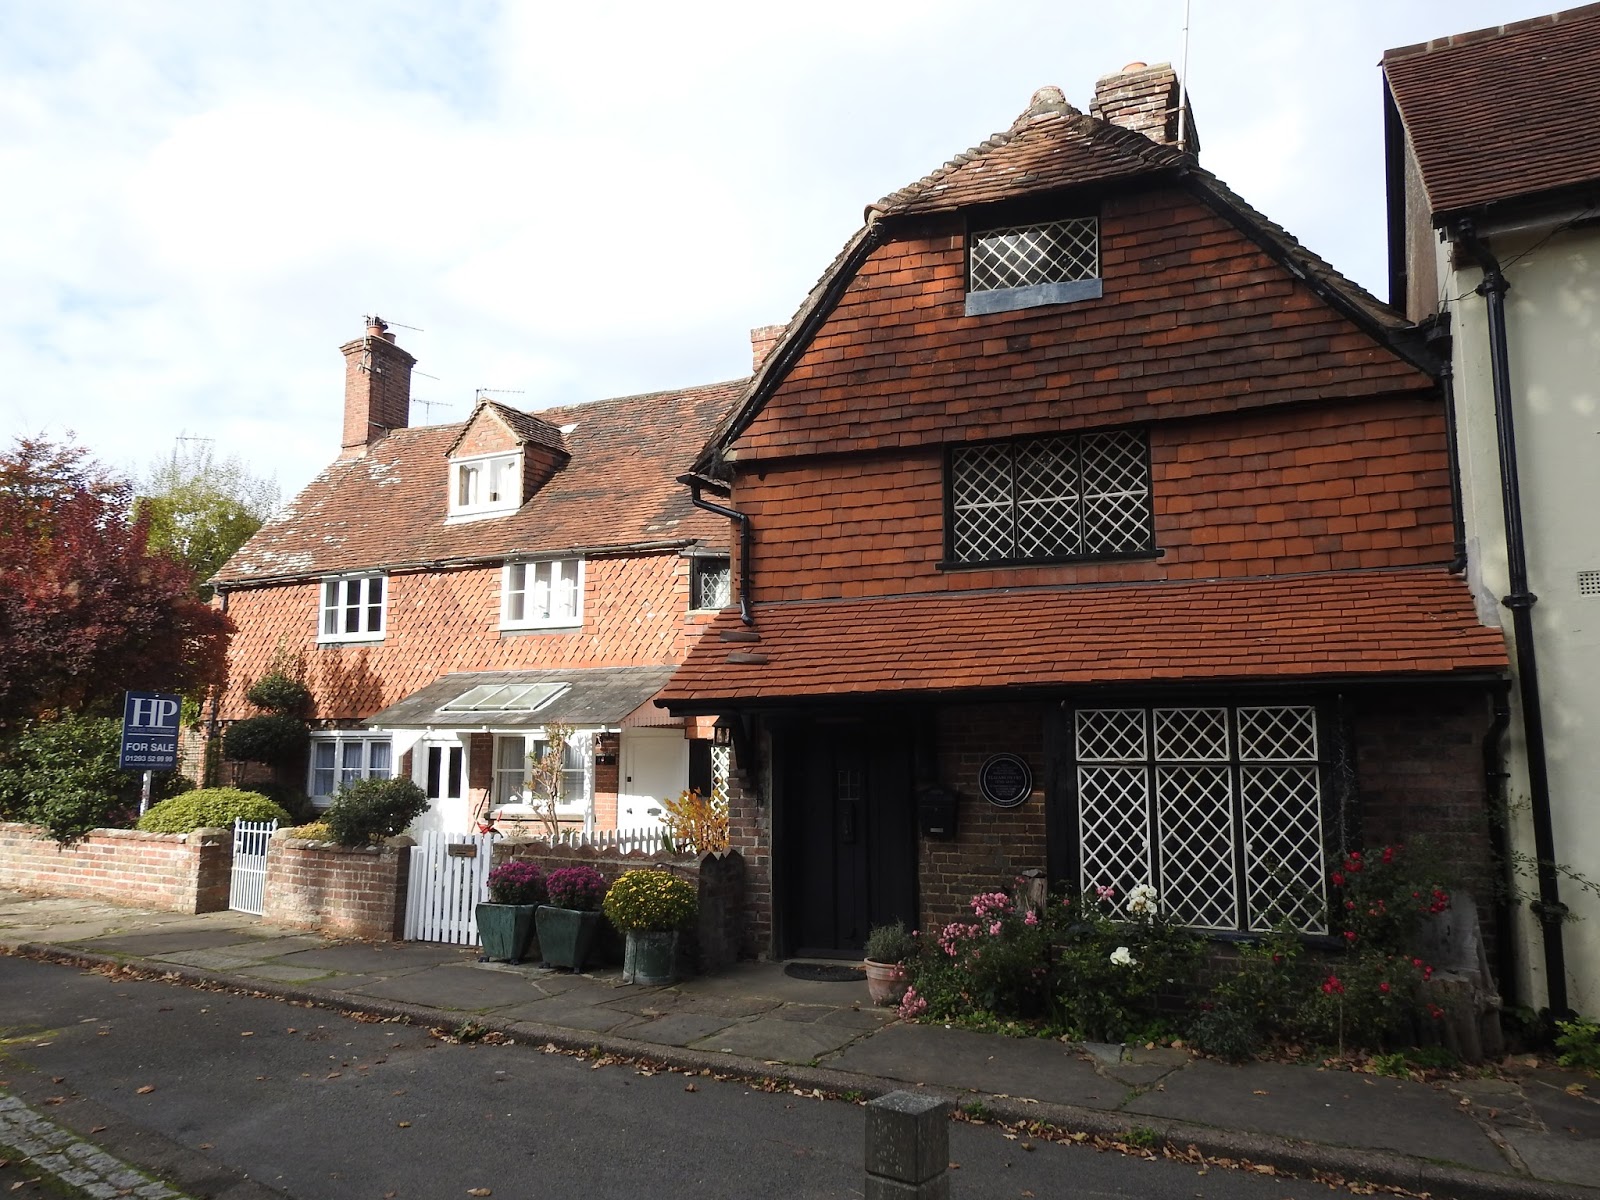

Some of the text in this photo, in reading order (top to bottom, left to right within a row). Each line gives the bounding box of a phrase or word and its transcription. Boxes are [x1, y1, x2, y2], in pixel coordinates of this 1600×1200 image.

[128, 698, 177, 728] HP
[126, 742, 174, 752] FOR SALE
